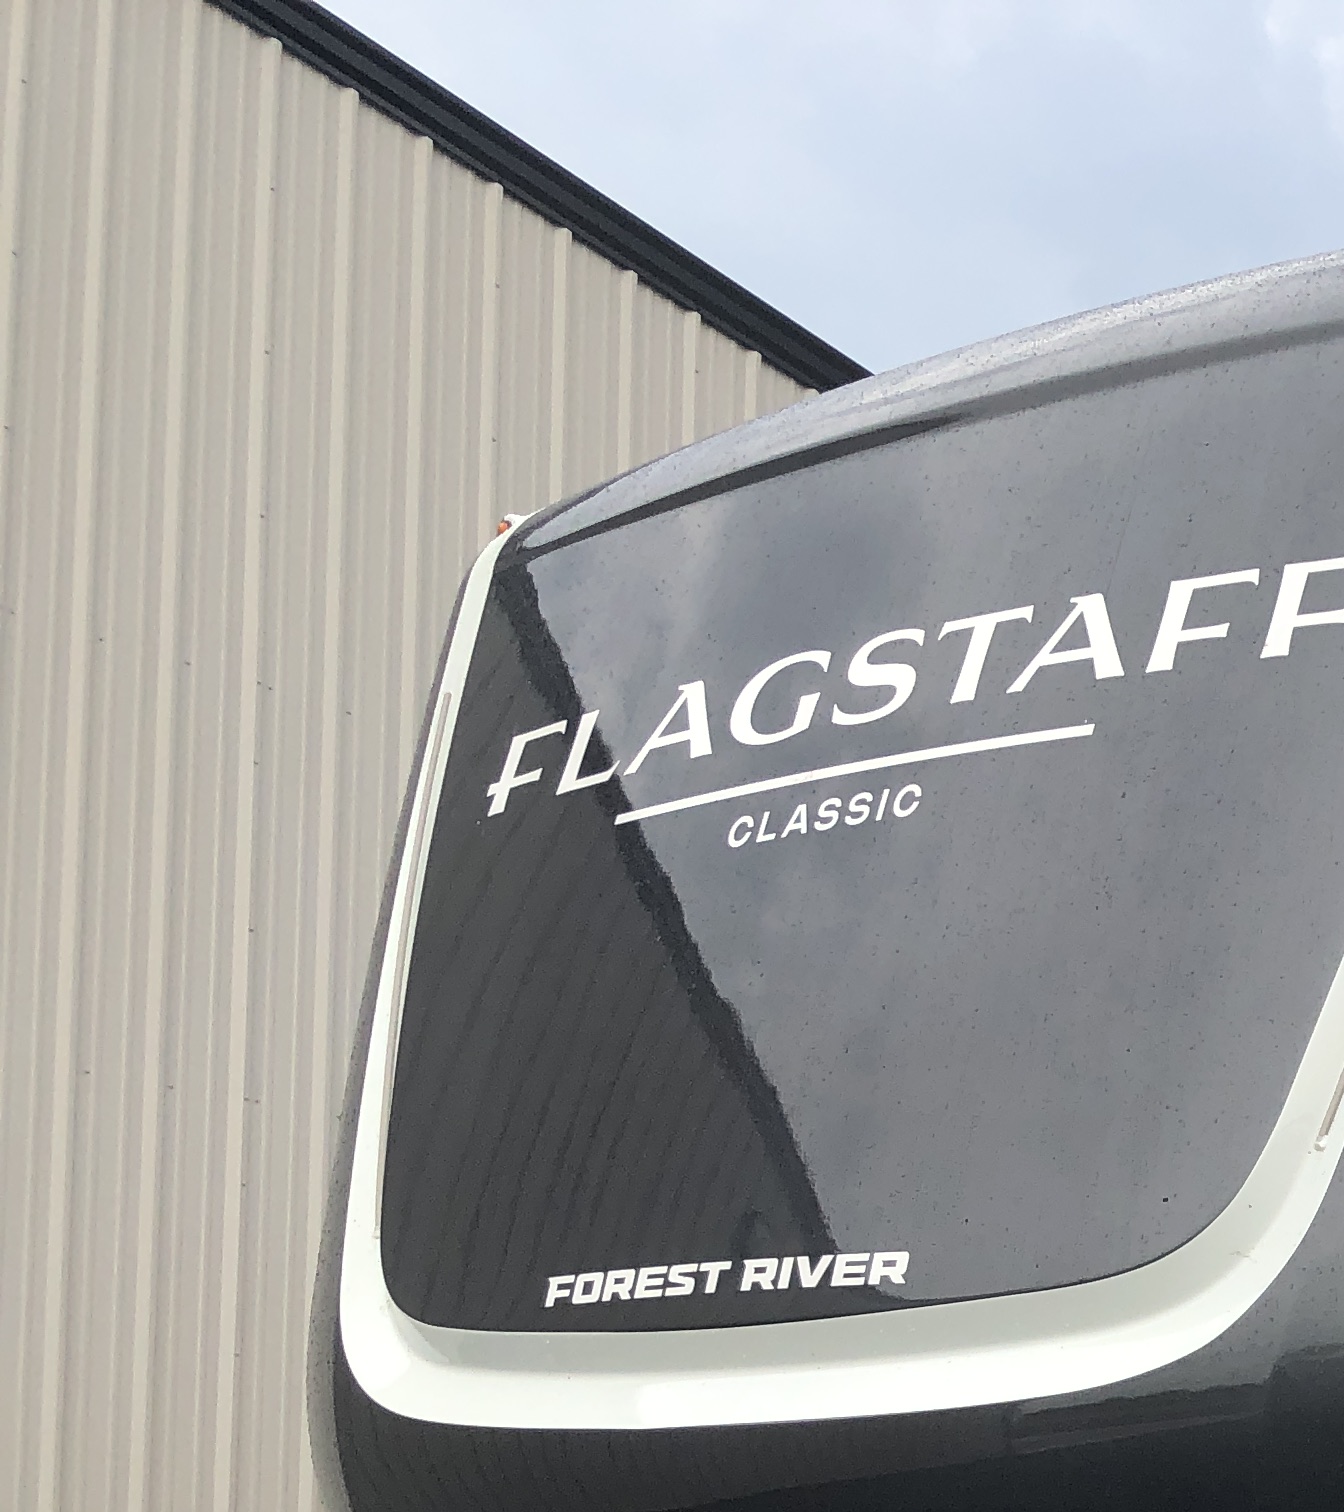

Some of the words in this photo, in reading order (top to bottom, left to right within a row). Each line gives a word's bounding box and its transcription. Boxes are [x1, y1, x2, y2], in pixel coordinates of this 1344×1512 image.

[727, 783, 923, 848] CLASSIC
[544, 1260, 733, 1308] FOREST
[739, 1250, 910, 1292] RIVER
